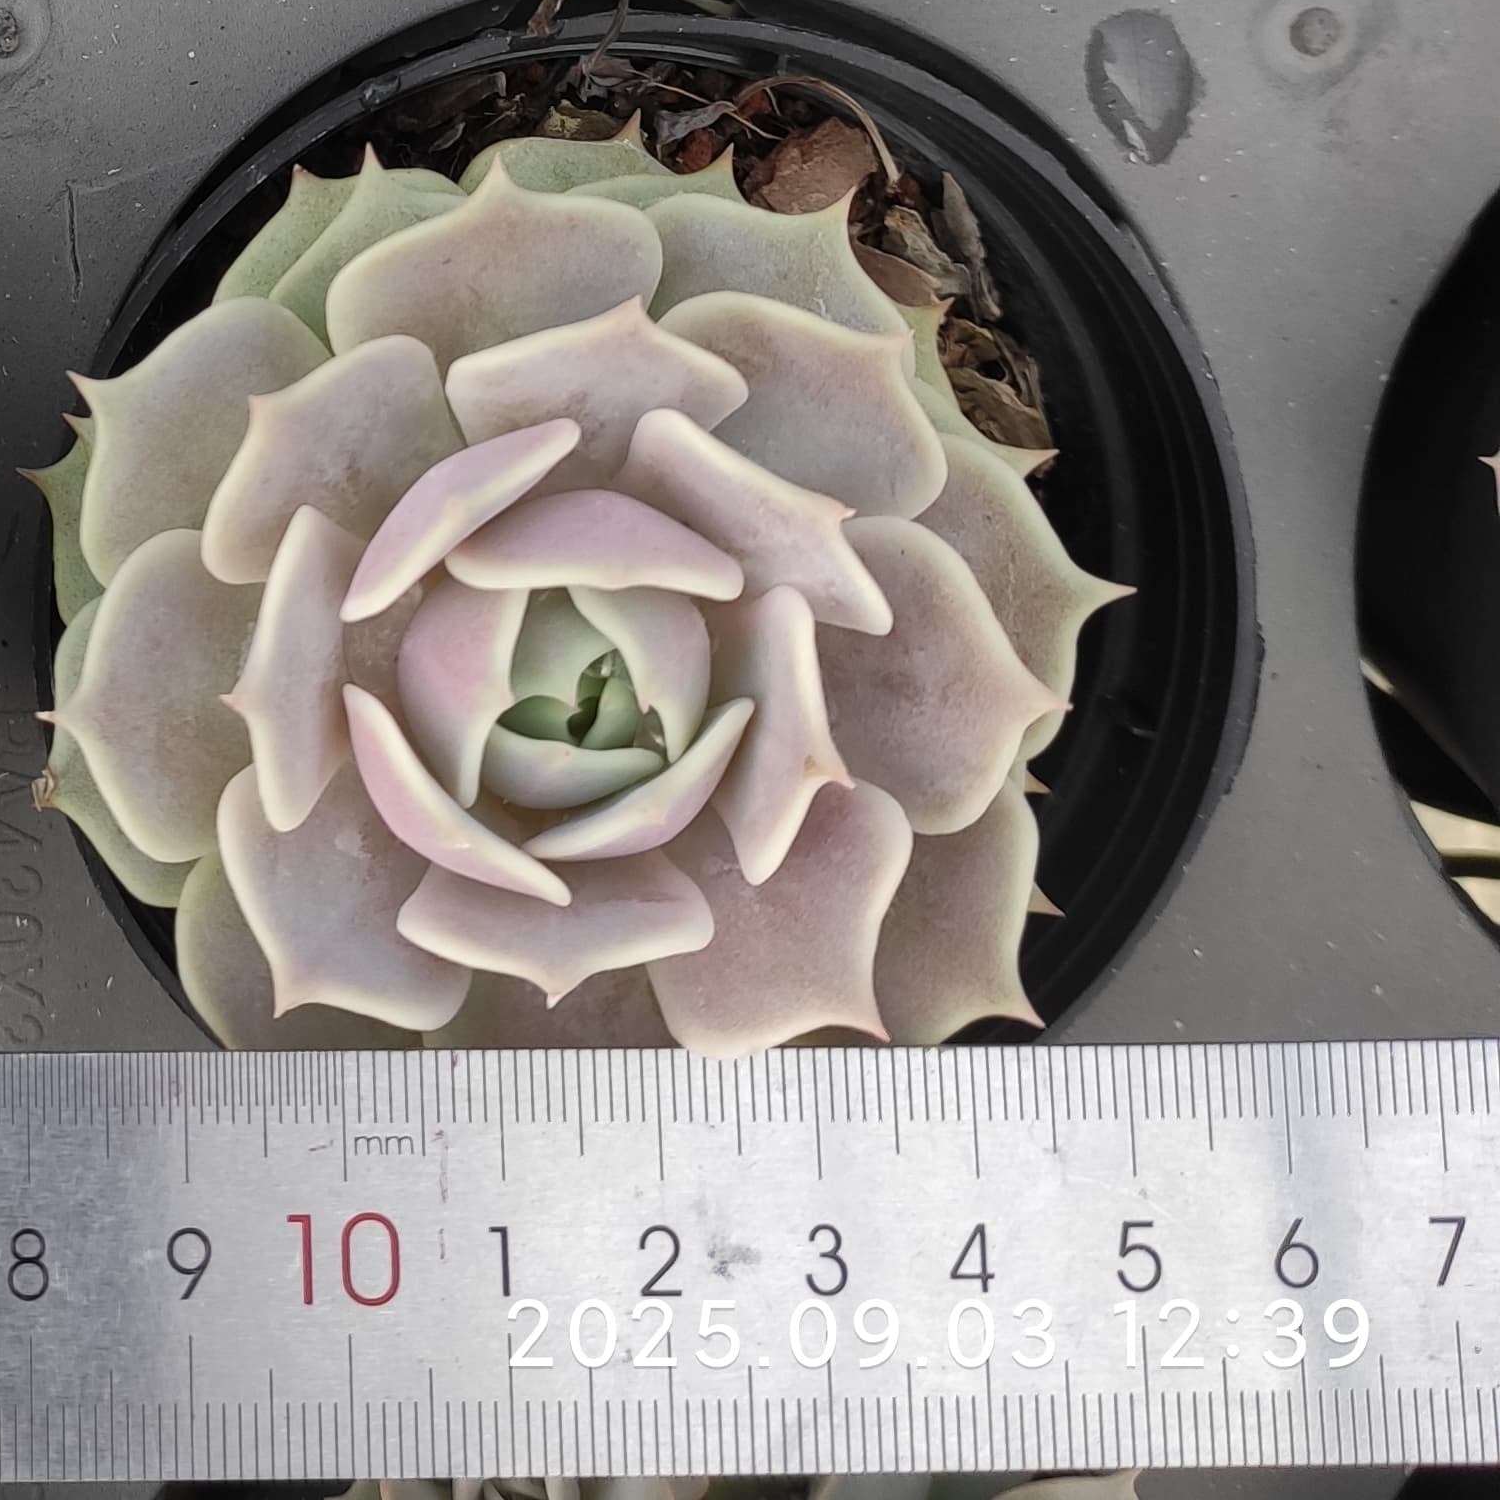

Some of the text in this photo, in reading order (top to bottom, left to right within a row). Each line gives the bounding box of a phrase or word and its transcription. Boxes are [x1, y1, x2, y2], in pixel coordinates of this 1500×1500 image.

[353, 1134, 415, 1156] mm
[8, 1228, 48, 1301] 8
[167, 1228, 211, 1300] 9
[287, 1213, 400, 1306] 10
[488, 1225, 511, 1298] 1
[639, 1225, 682, 1297] 2
[806, 1224, 848, 1296] 3
[950, 1223, 995, 1293] 4
[1117, 1221, 1162, 1293] 5
[1275, 1218, 1319, 1289] 6
[1429, 1216, 1466, 1287] 7
